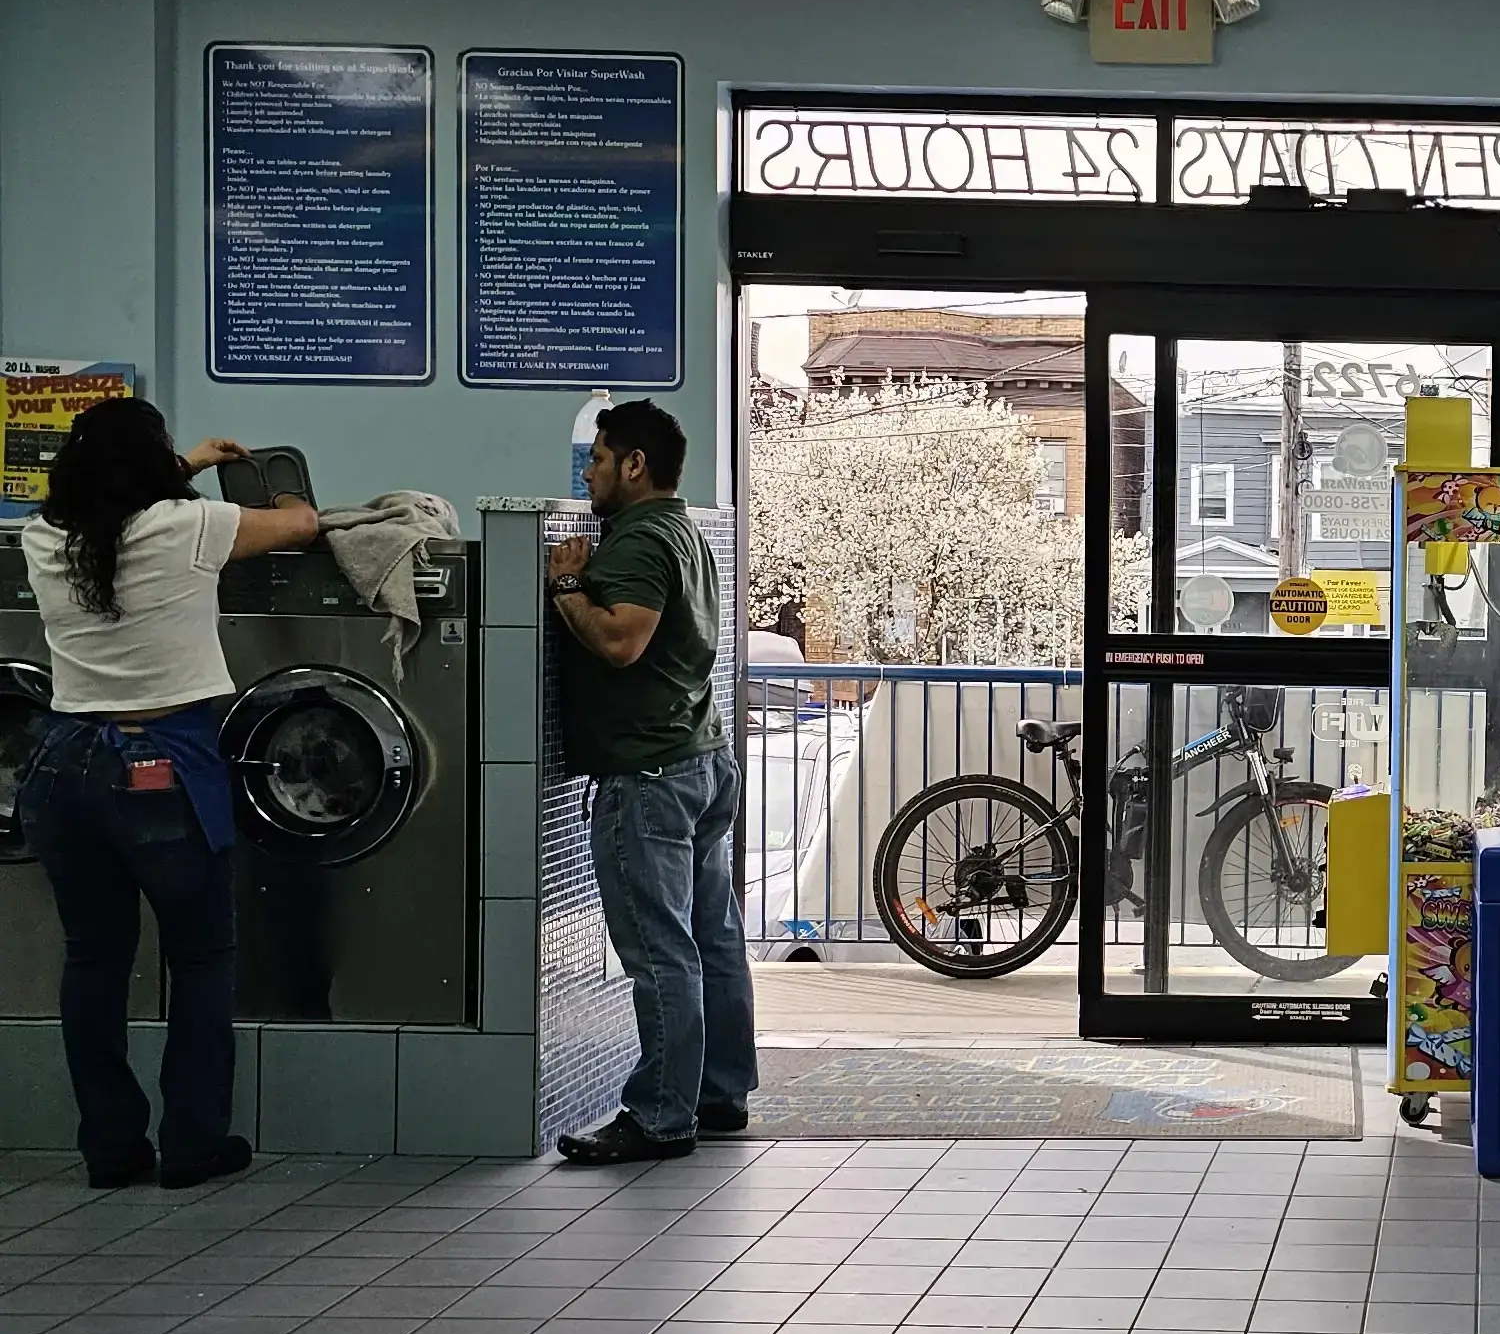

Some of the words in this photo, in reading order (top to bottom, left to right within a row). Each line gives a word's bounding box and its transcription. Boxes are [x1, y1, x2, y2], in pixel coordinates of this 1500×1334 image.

[224, 61, 254, 70] Thank
[257, 63, 275, 72] you
[279, 61, 293, 71] for
[295, 64, 330, 73] visiting
[498, 68, 533, 77] Gracias
[537, 68, 553, 77] Por
[556, 69, 588, 78] Visitar
[591, 69, 645, 80] SuperWash
[5, 362, 17, 372] 20
[480, 361, 517, 369] DISFRUTE
[520, 361, 544, 369] LAVAR
[546, 362, 557, 370] EN
[5, 374, 125, 396] SUPERSIZE
[7, 398, 56, 419] your
[1275, 590, 1323, 598] AUTOMATIC
[1272, 601, 1324, 612] CAUTION
[1287, 616, 1310, 624] DOOR
[449, 623, 457, 634] 1
[1106, 652, 1113, 662] IN
[1114, 652, 1154, 664] EMERGENCY
[1156, 653, 1173, 664] PUSH
[1176, 653, 1185, 664] TO
[1186, 654, 1204, 665] OPEN
[1184, 729, 1232, 761] ANCHEER
[1421, 900, 1472, 931] SWE
